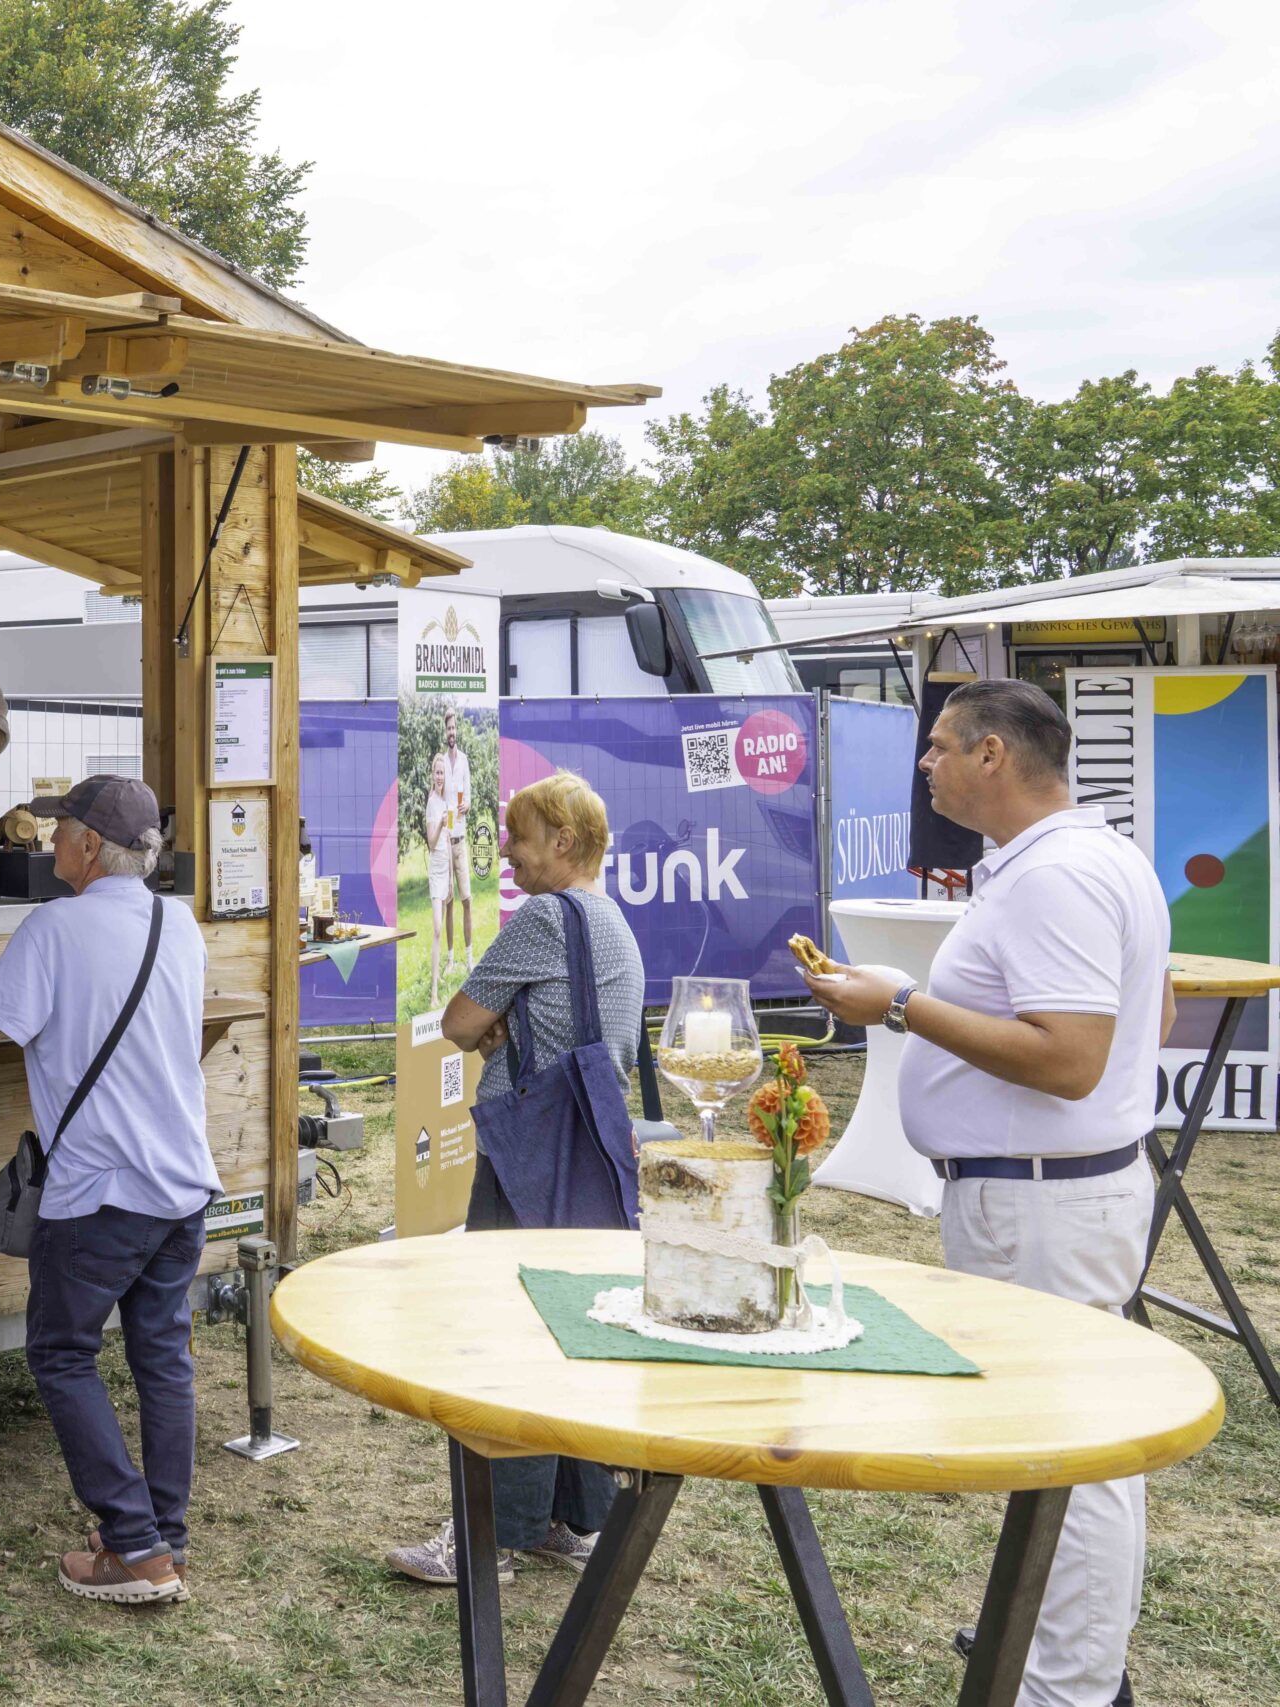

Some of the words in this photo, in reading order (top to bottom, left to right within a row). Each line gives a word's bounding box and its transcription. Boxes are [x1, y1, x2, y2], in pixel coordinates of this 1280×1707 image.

[416, 644, 486, 673] BRAUSCHMIDL
[418, 680, 439, 688] BADISCH
[441, 681, 467, 689] BAYERISCH
[743, 733, 798, 756] RADIO
[757, 755, 788, 776] AN!
[837, 808, 911, 885] SÜDKURI
[415, 1020, 440, 1036] WWW.B
